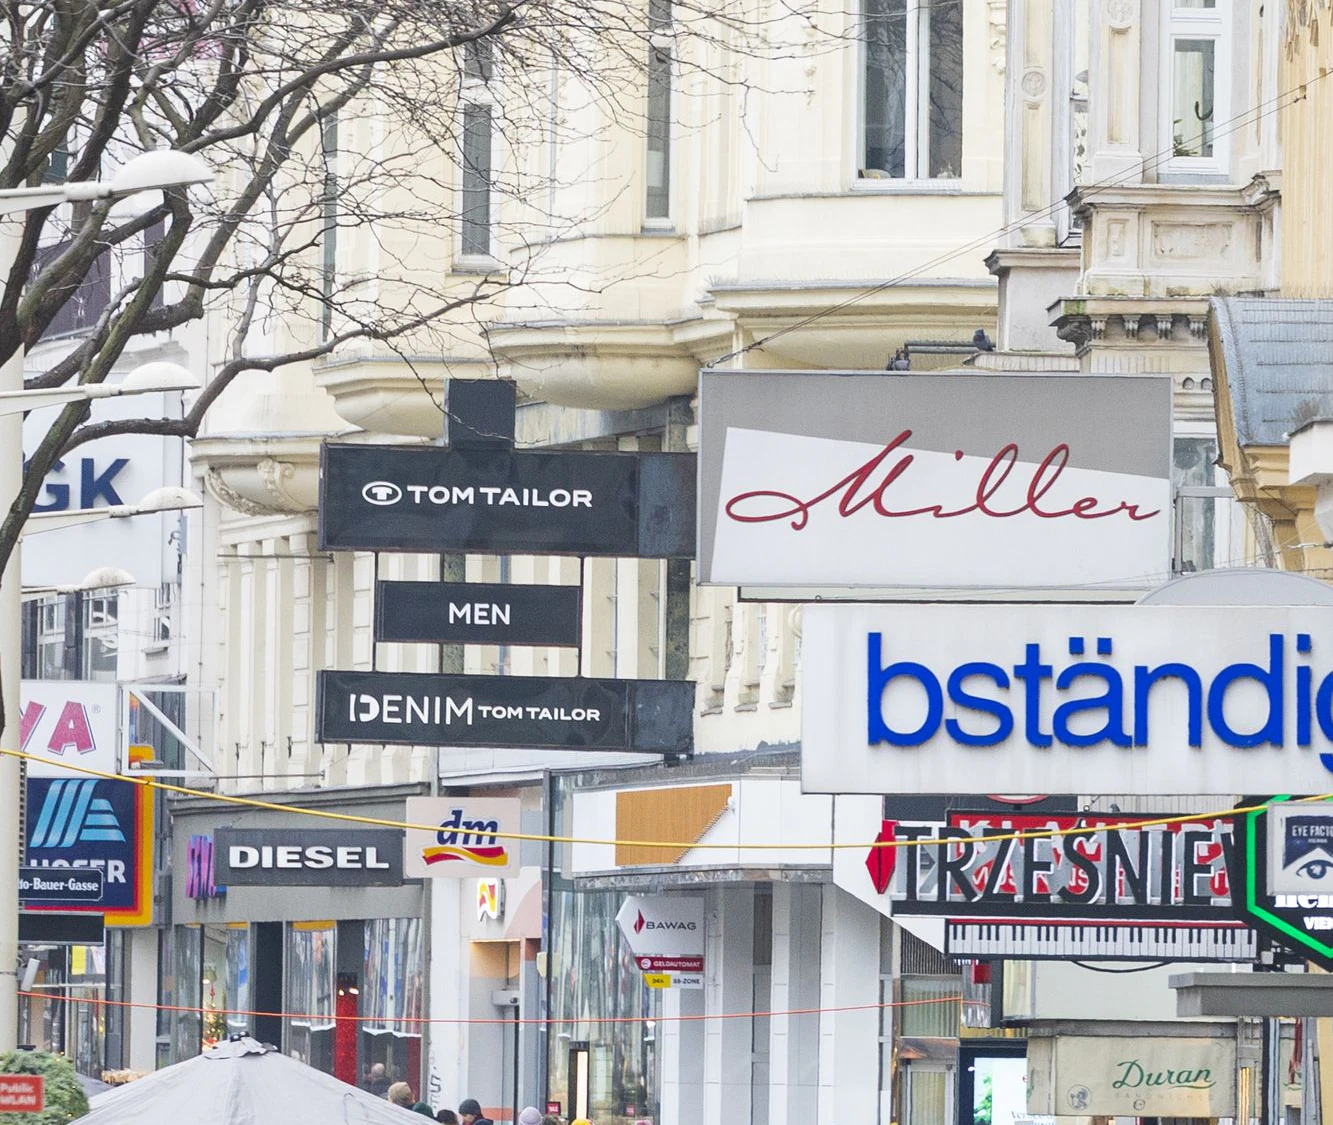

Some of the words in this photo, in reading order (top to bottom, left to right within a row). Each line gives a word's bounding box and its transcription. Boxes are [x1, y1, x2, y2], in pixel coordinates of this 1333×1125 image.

[725, 429, 1161, 531] Miller
[406, 485, 475, 505] TOM
[479, 487, 593, 508] TAILOR
[448, 602, 511, 625] MEN
[349, 693, 473, 725] DENIM
[477, 705, 523, 719] TOM
[525, 706, 601, 721] TAILOR
[436, 809, 499, 845] dm
[1292, 825, 1308, 837] EYE
[228, 845, 390, 869] DIESEL
[646, 921, 697, 931] BAWAG
[1112, 1059, 1217, 1090] Duran
